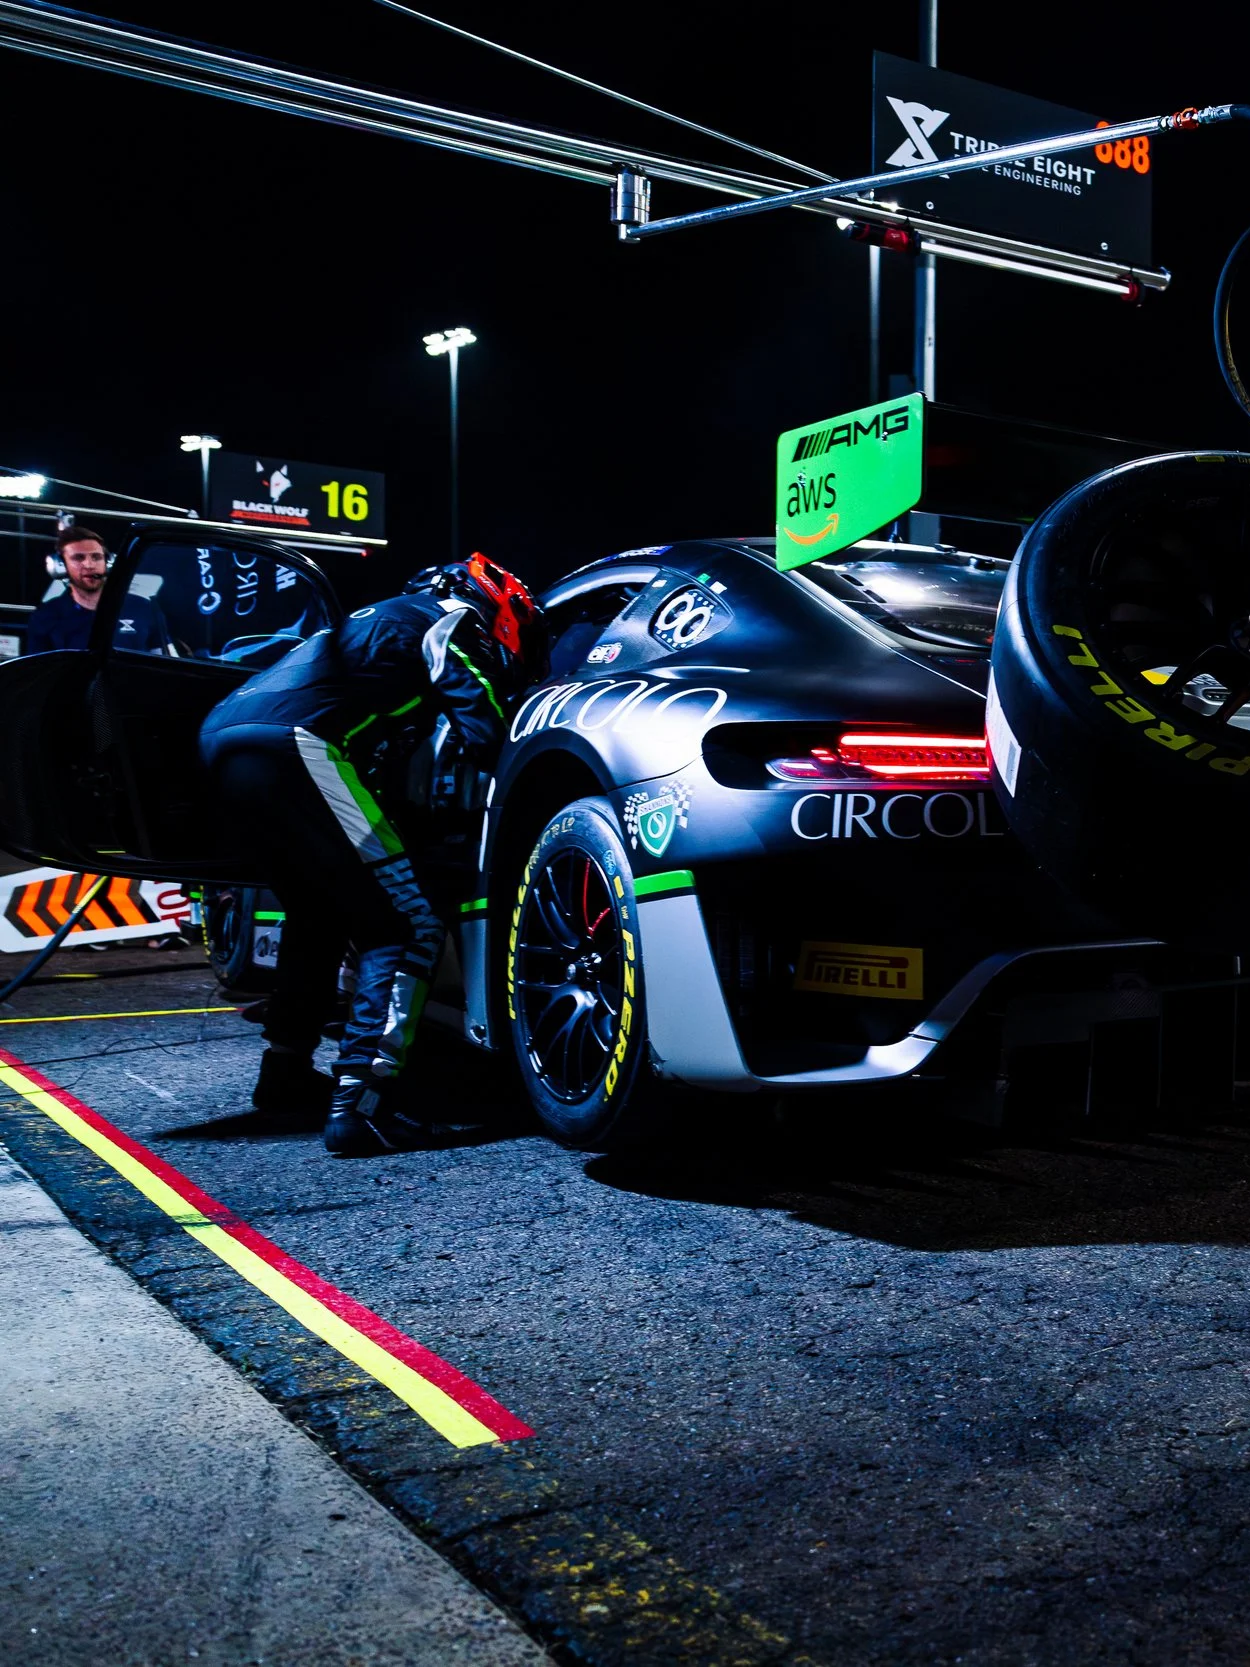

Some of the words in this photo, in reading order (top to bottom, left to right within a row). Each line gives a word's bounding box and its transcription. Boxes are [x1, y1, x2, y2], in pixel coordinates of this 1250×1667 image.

[994, 165, 1082, 196] ENGINEERING
[1033, 156, 1096, 185] EIGHT
[824, 406, 909, 453] AMG
[232, 500, 273, 514] BLACK
[274, 504, 309, 518] WOLF
[320, 480, 369, 522] 16
[787, 473, 836, 517] aws
[510, 680, 727, 742] CIRCOLO
[791, 792, 1005, 840] CIRCOL
[803, 951, 909, 989] PIRELLI
